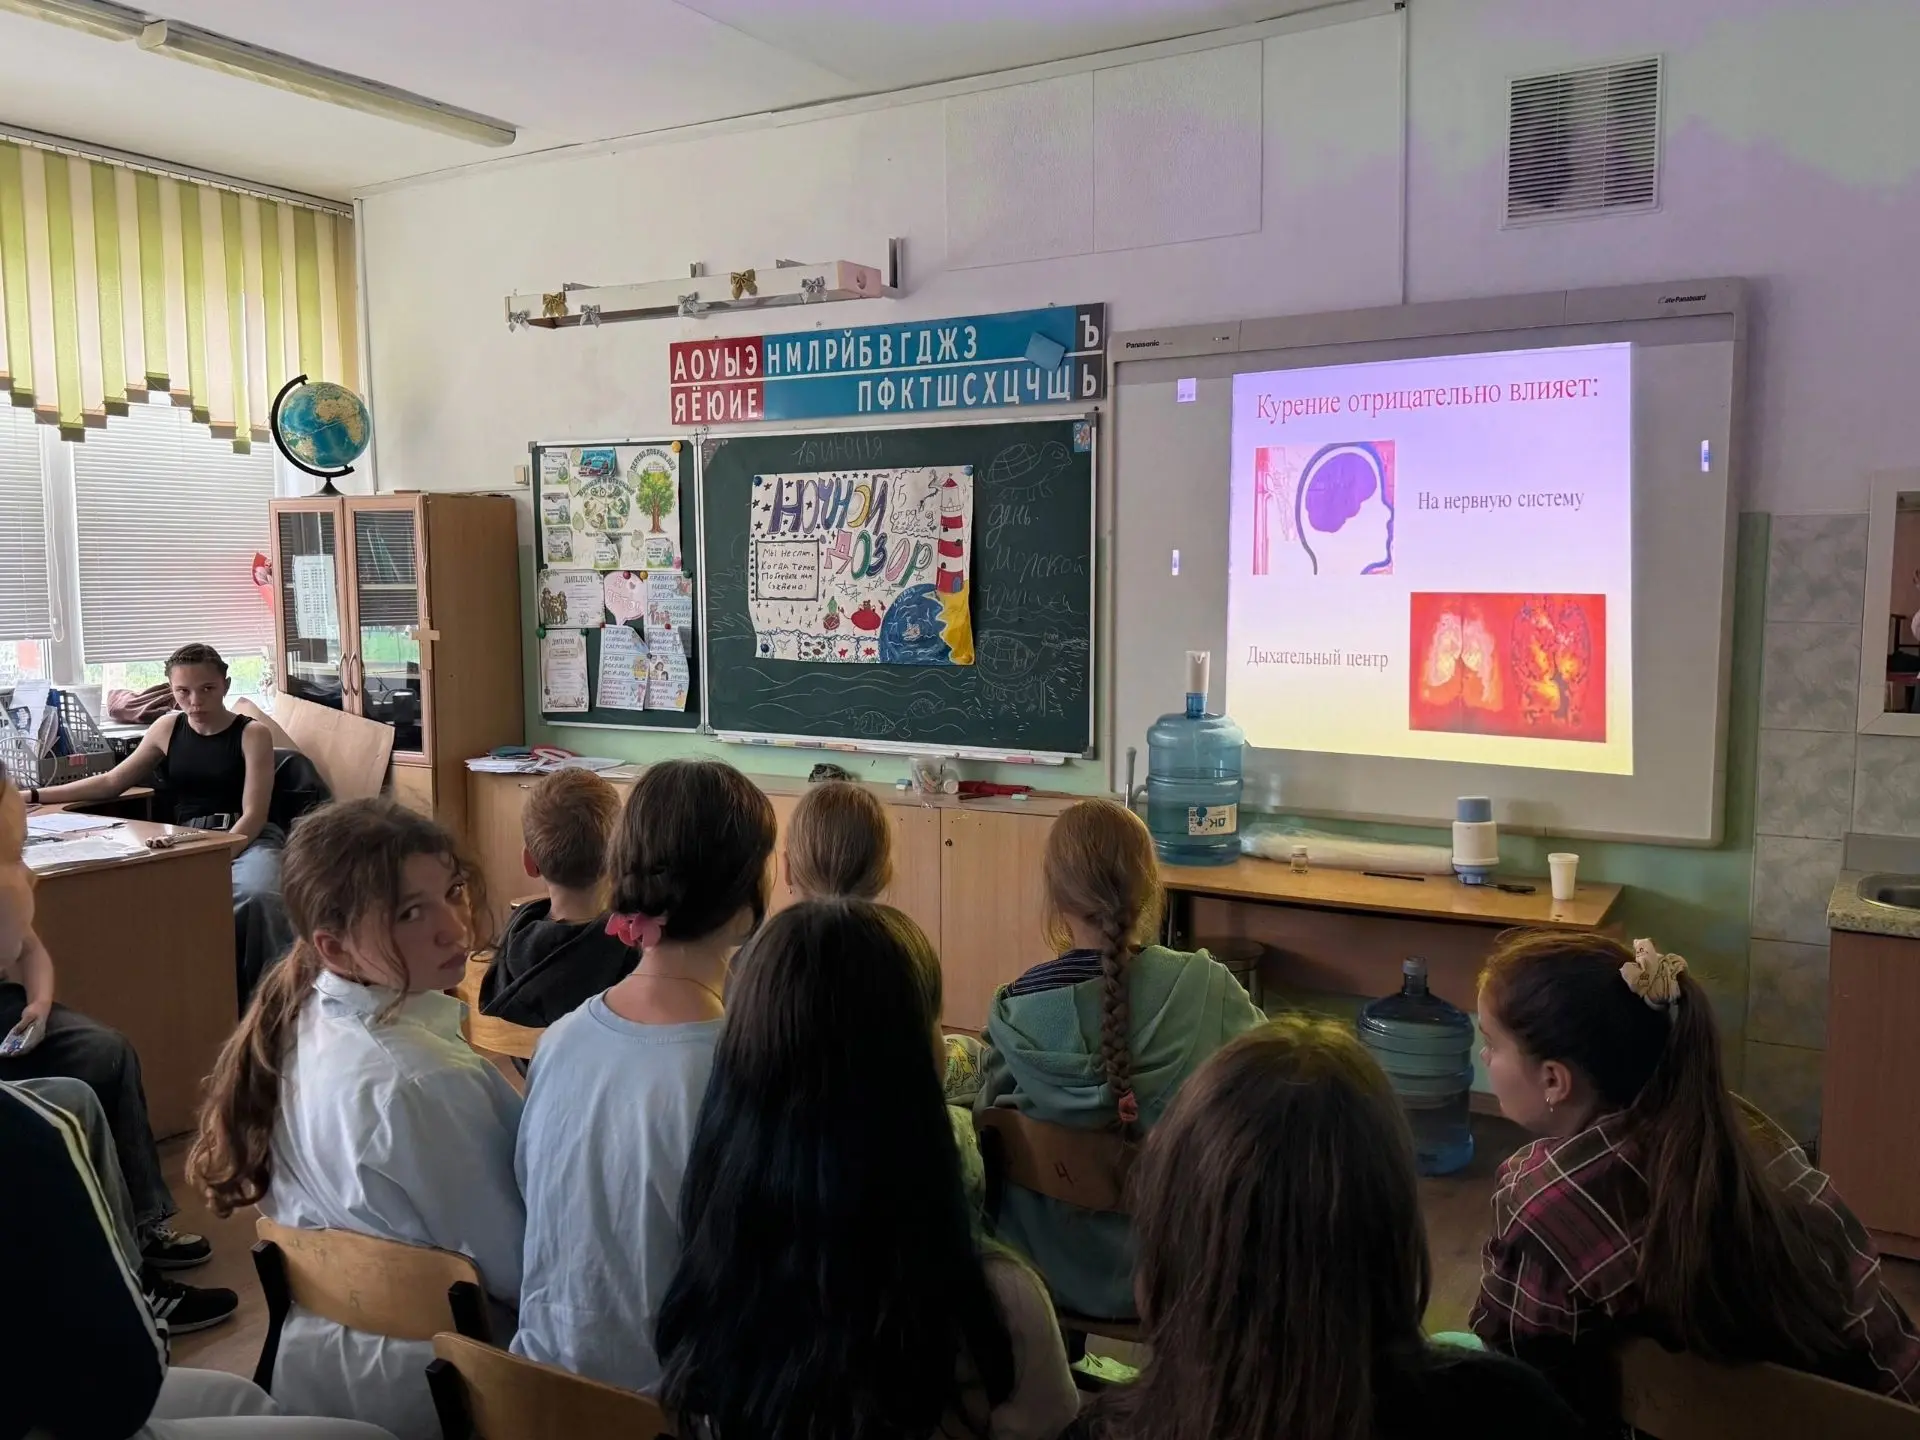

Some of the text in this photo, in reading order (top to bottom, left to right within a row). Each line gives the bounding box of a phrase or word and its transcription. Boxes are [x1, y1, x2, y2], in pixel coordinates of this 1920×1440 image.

[674, 344, 759, 381] АОУЫЭ
[1126, 340, 1160, 349] Panasonic
[674, 387, 759, 422] ЯЁЮИЕ
[1256, 375, 1599, 424] Курение отрицательно влияет:
[767, 473, 890, 535] НОЧНОЙ
[1418, 491, 1584, 514] На нервную систему
[824, 528, 933, 587] ДОЗОР
[1247, 645, 1389, 672] Дыхательный центр
